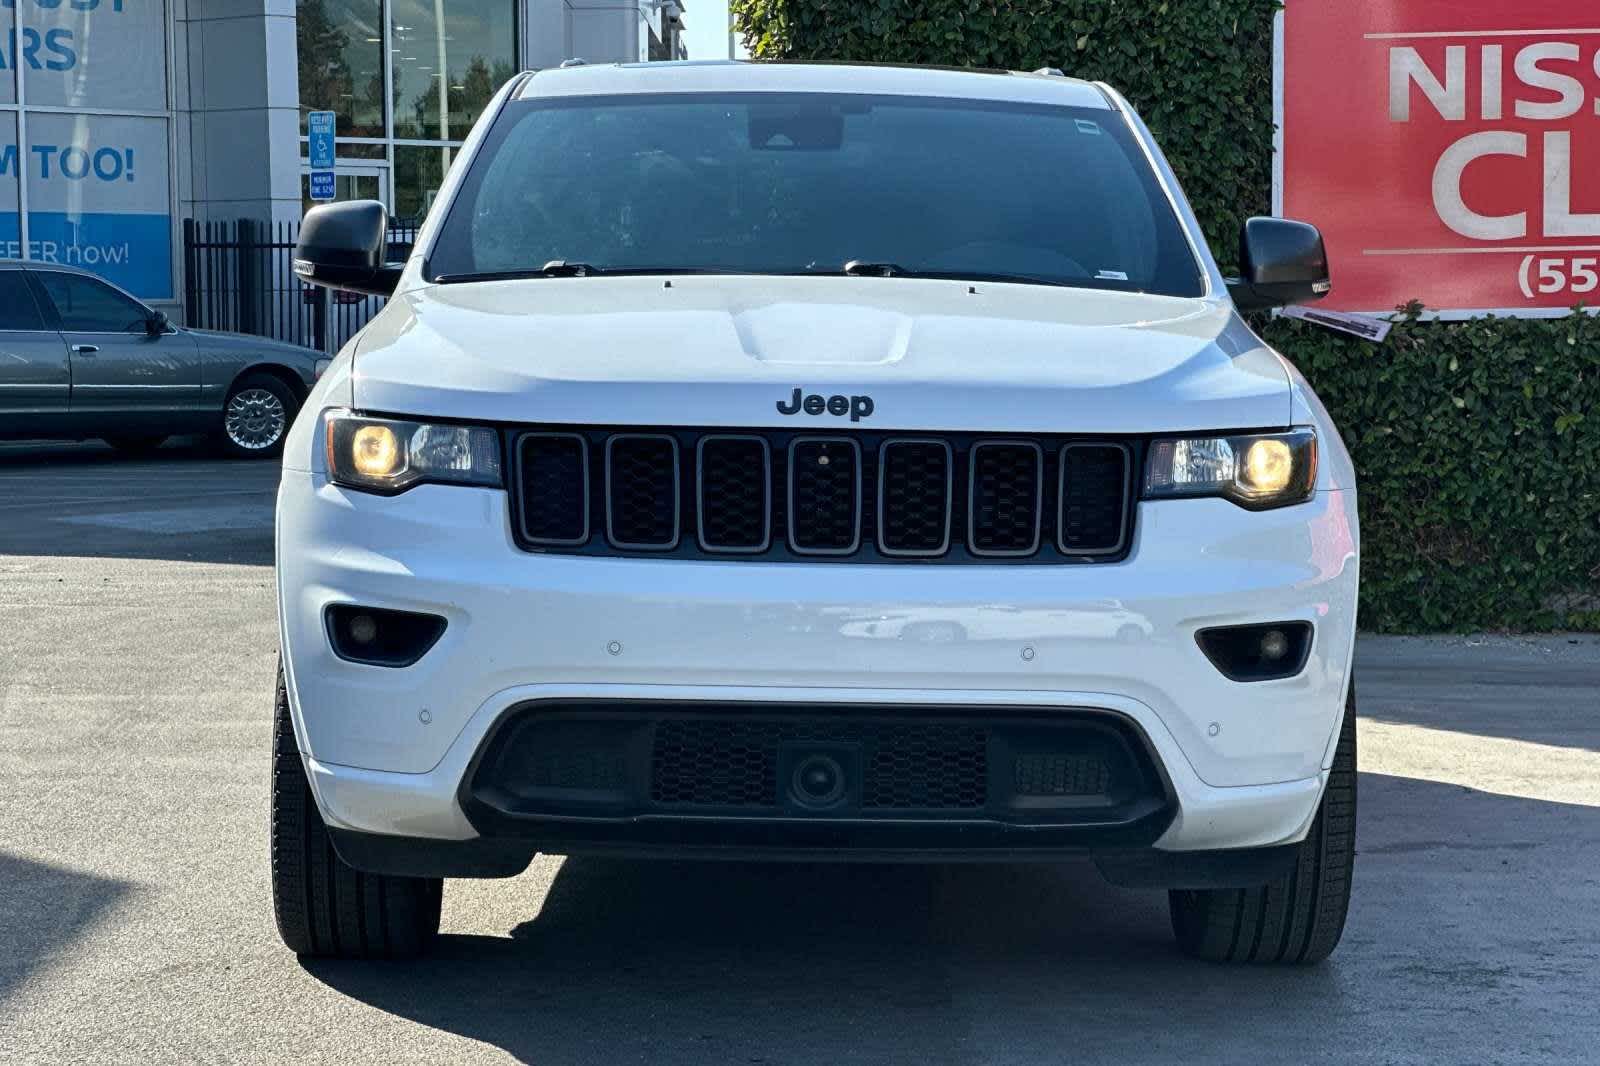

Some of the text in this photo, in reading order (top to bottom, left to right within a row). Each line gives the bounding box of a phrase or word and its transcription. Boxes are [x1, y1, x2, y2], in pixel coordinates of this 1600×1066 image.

[0, 27, 76, 71] RS
[1389, 42, 1600, 121] NIS
[31, 145, 135, 182] TOO!
[67, 243, 129, 264] now!
[776, 388, 875, 422] Jeep
